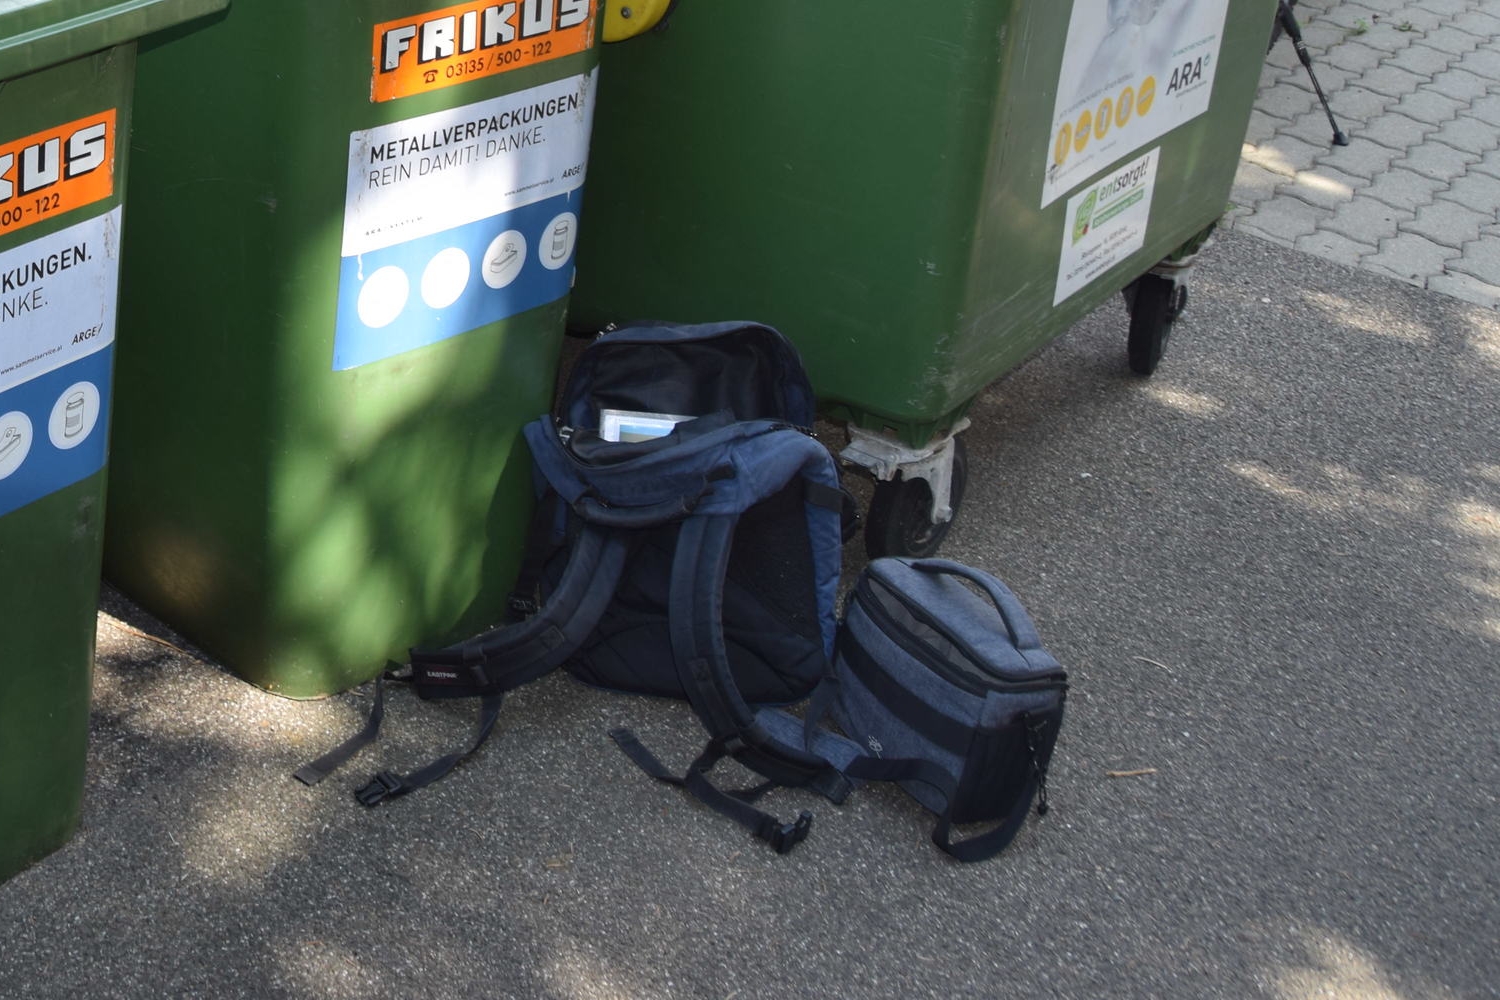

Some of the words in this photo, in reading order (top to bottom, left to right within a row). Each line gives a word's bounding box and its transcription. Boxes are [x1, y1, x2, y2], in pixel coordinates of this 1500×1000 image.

[1166, 57, 1202, 96] ARA
[370, 92, 578, 164] METALLVERPACKUNGEN
[368, 162, 412, 189] REIN
[419, 143, 480, 176] DAMIT!
[485, 126, 546, 159] DANKE.
[1100, 156, 1150, 201] entsorgt!
